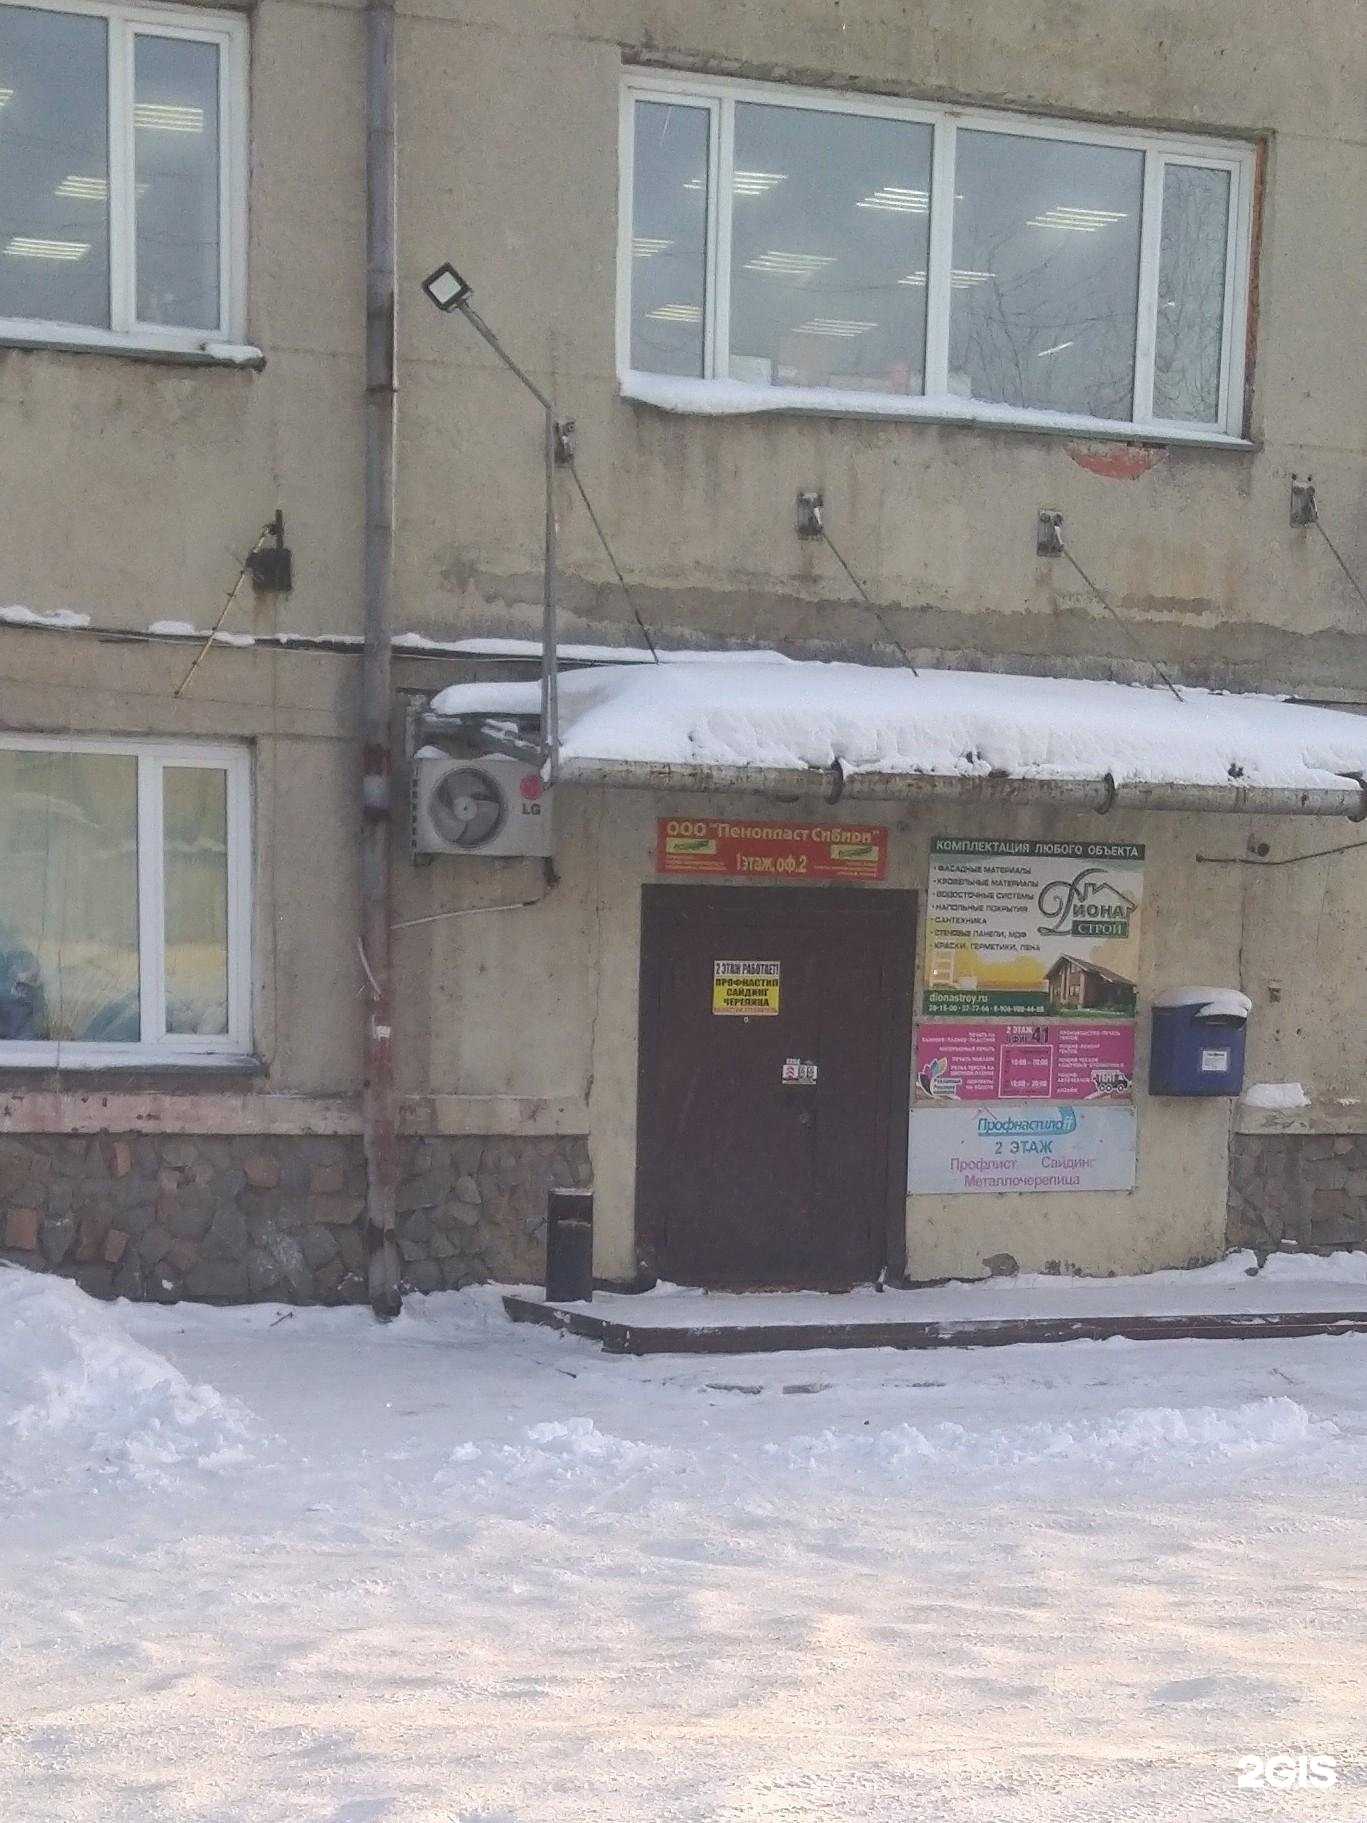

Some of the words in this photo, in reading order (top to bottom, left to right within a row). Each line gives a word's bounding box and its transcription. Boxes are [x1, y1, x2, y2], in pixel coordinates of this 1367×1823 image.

[522, 803, 541, 815] LG
[666, 821, 707, 837] ООО
[936, 840, 1030, 853] КОМПЛЕКТАЦИЯ
[1034, 843, 1083, 855] ЛЮБОГО
[1088, 844, 1139, 857] ОБЪЕКТА
[937, 865, 982, 874] ФАСАДНЫЕ
[984, 866, 1032, 875] МАТЕРИАЛЫ
[936, 878, 989, 888] КРОВЕЛЬНЫЕ
[991, 879, 1039, 889] МАТЕРИАЛЫ
[936, 891, 994, 900] ВОДОСТОЧНЫЕ
[996, 892, 1034, 901] СИСТЕМЫ
[935, 904, 984, 913] НАПОЛЬНЫЕ
[986, 904, 1029, 913] ПОКРЫТИЯ
[935, 916, 987, 925] САНТЕХНИКА
[1078, 922, 1124, 935] СТРОЙ
[715, 979, 779, 987] ПРОФНАСТИЛ
[726, 988, 769, 997] САЙДИНГ
[929, 992, 989, 1004] dionastroy.ru
[1012, 1026, 1033, 1035] ЭТАЖ
[1031, 1026, 1049, 1043] 41
[995, 1141, 1002, 1154] 2
[1010, 1140, 1053, 1154] ЭТАЖ
[950, 1157, 1018, 1172] Профлист
[1041, 1156, 1096, 1169] Сайдинг
[964, 1174, 1081, 1188] Металлочерепица
